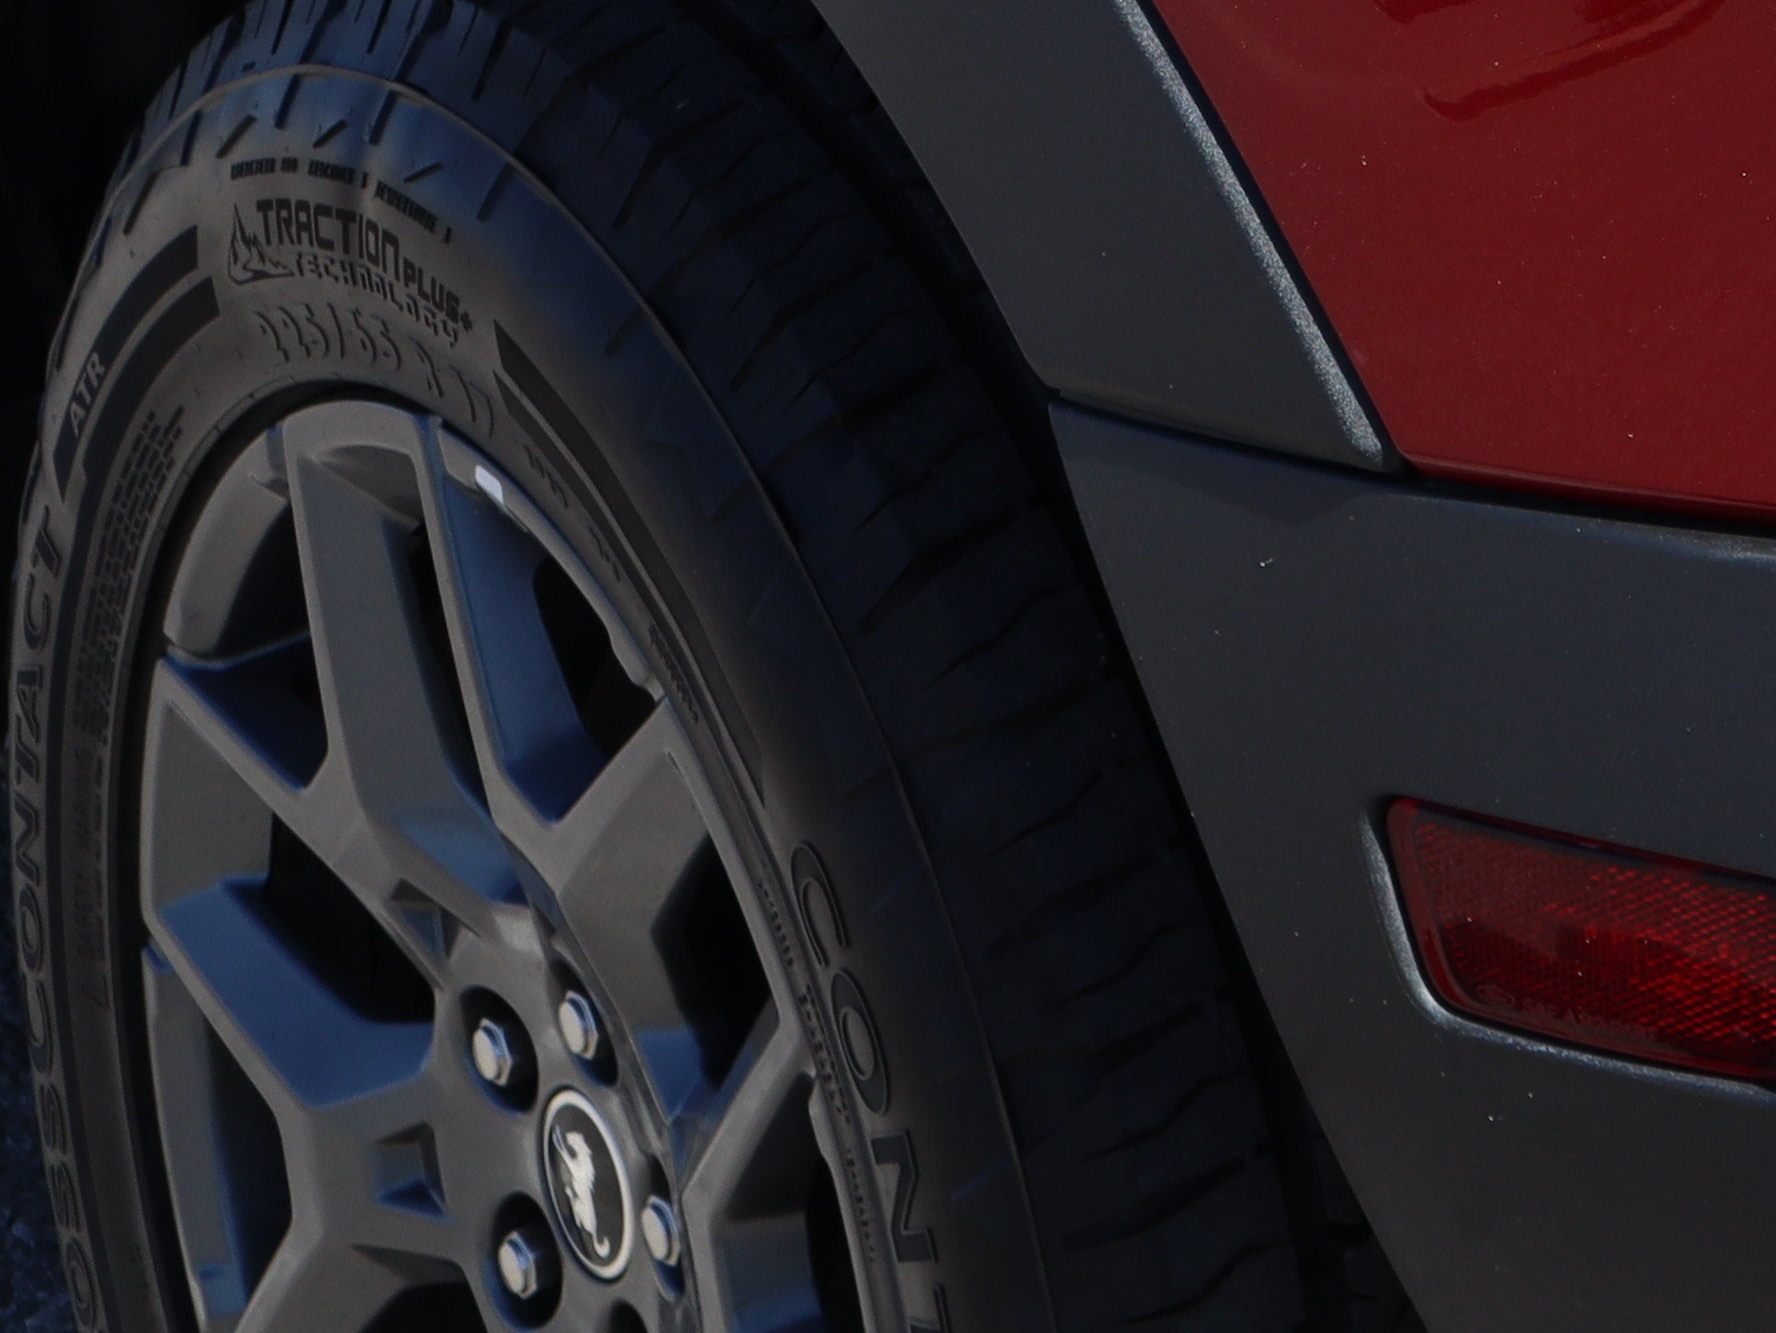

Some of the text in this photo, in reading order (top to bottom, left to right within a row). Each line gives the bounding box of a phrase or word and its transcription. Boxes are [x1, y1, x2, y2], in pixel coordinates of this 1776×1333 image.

[255, 197, 402, 282] TRACTION
[68, 351, 107, 438] ATR
[13, 504, 99, 1333] OSSCONTACT
